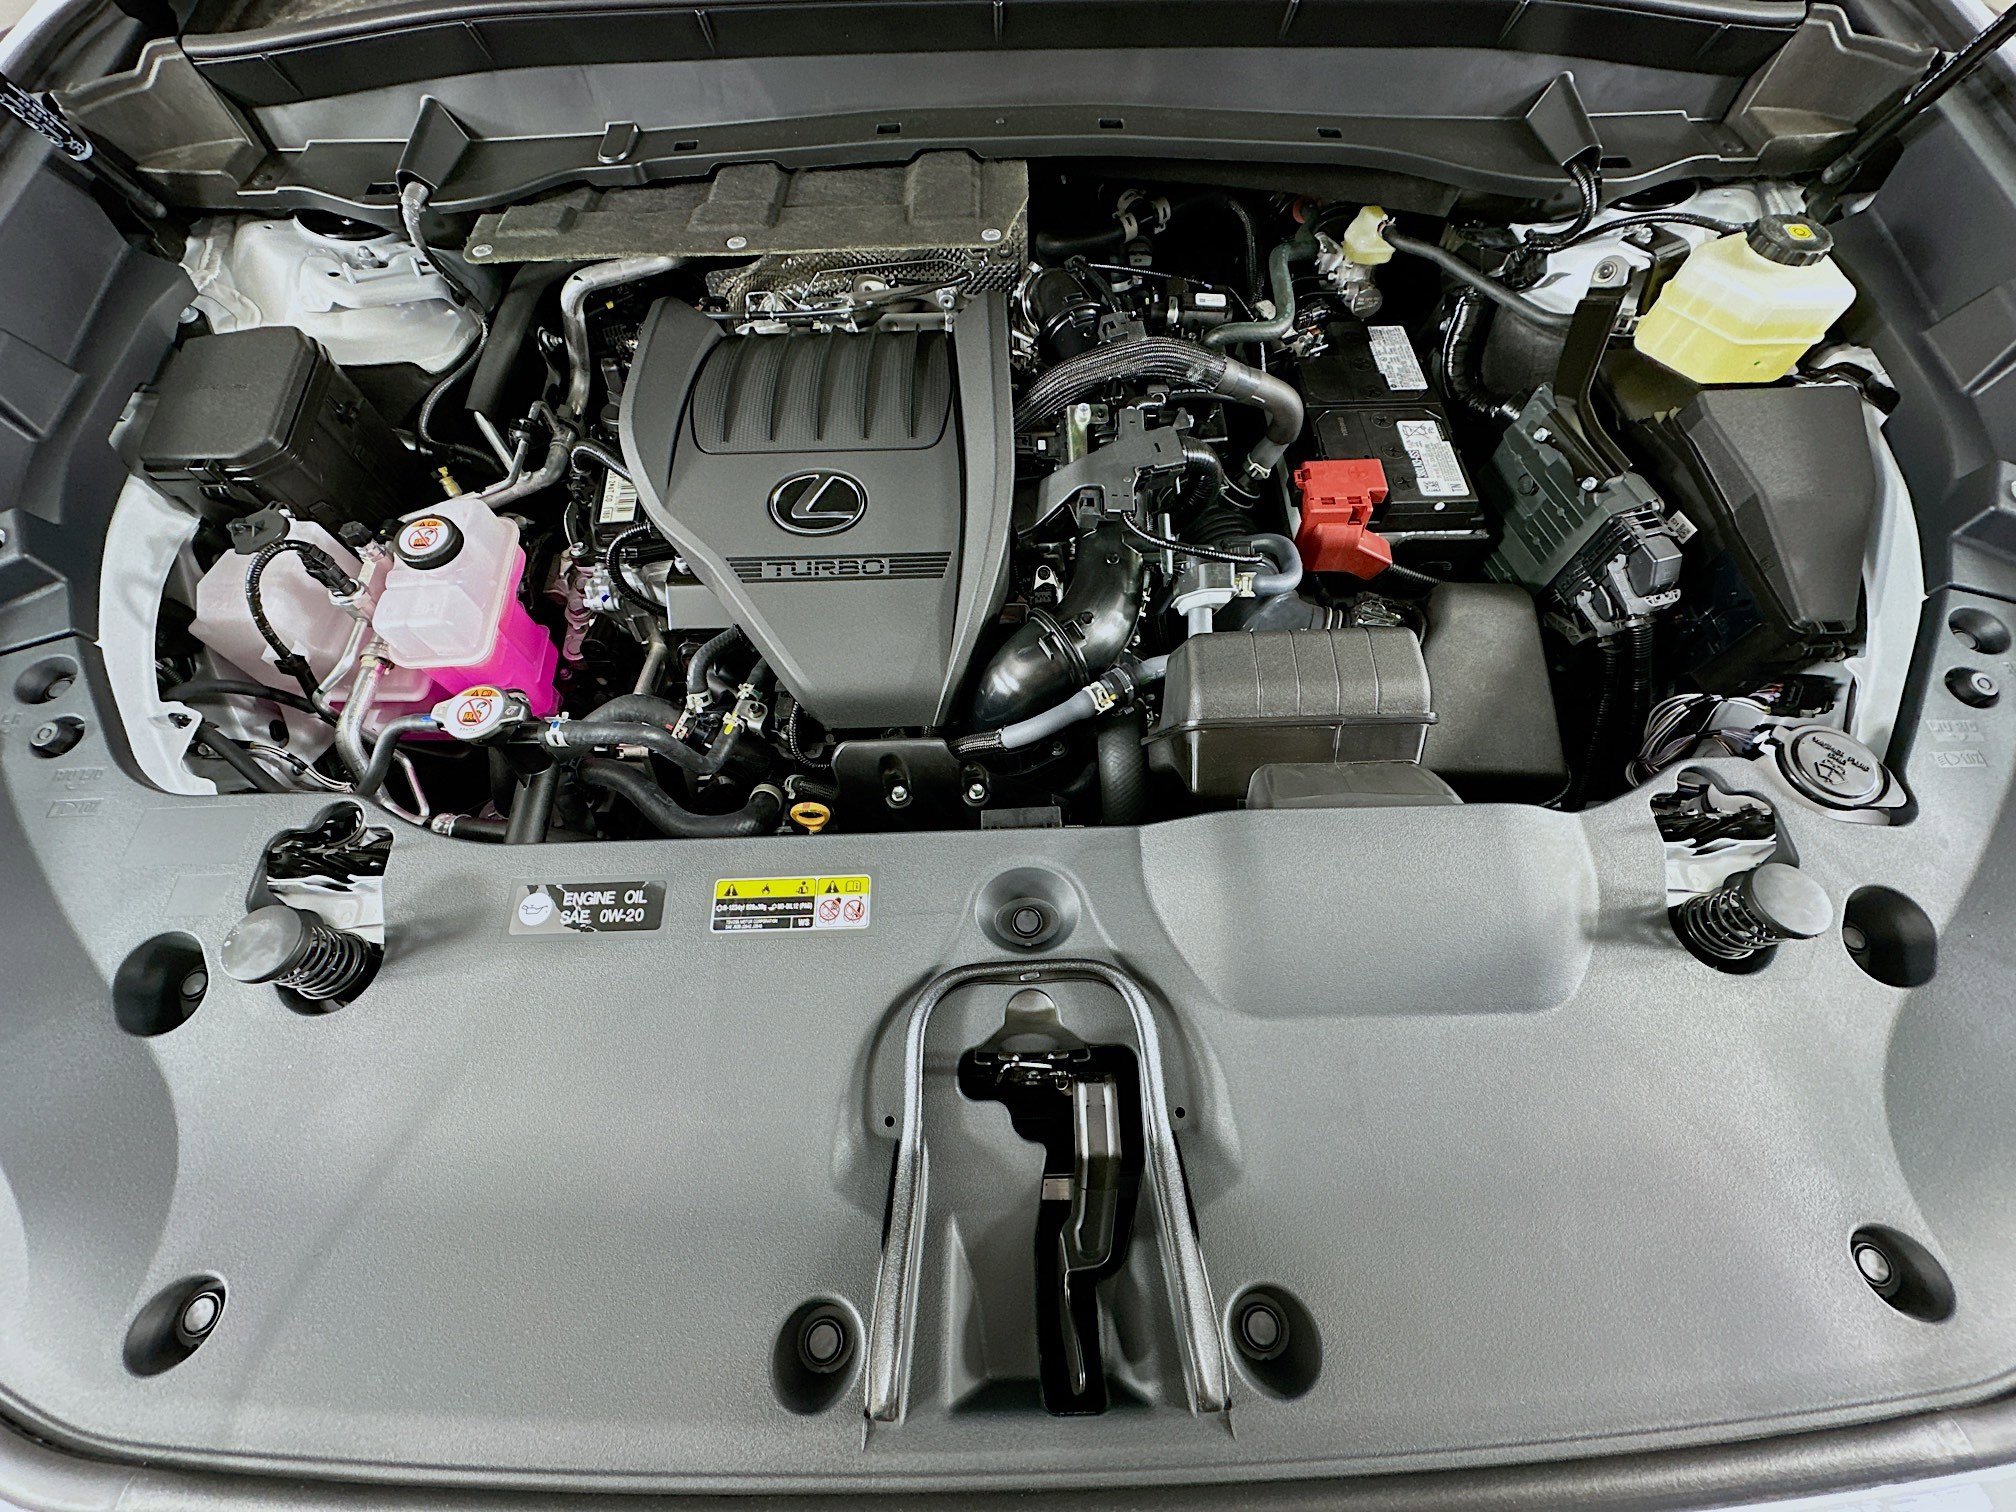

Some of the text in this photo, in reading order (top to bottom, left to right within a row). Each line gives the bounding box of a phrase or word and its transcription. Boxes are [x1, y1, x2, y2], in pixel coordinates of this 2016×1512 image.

[766, 559, 885, 577] TURBO
[562, 889, 648, 906] ENGINE OIL
[560, 907, 645, 925] SAE 0W-20
